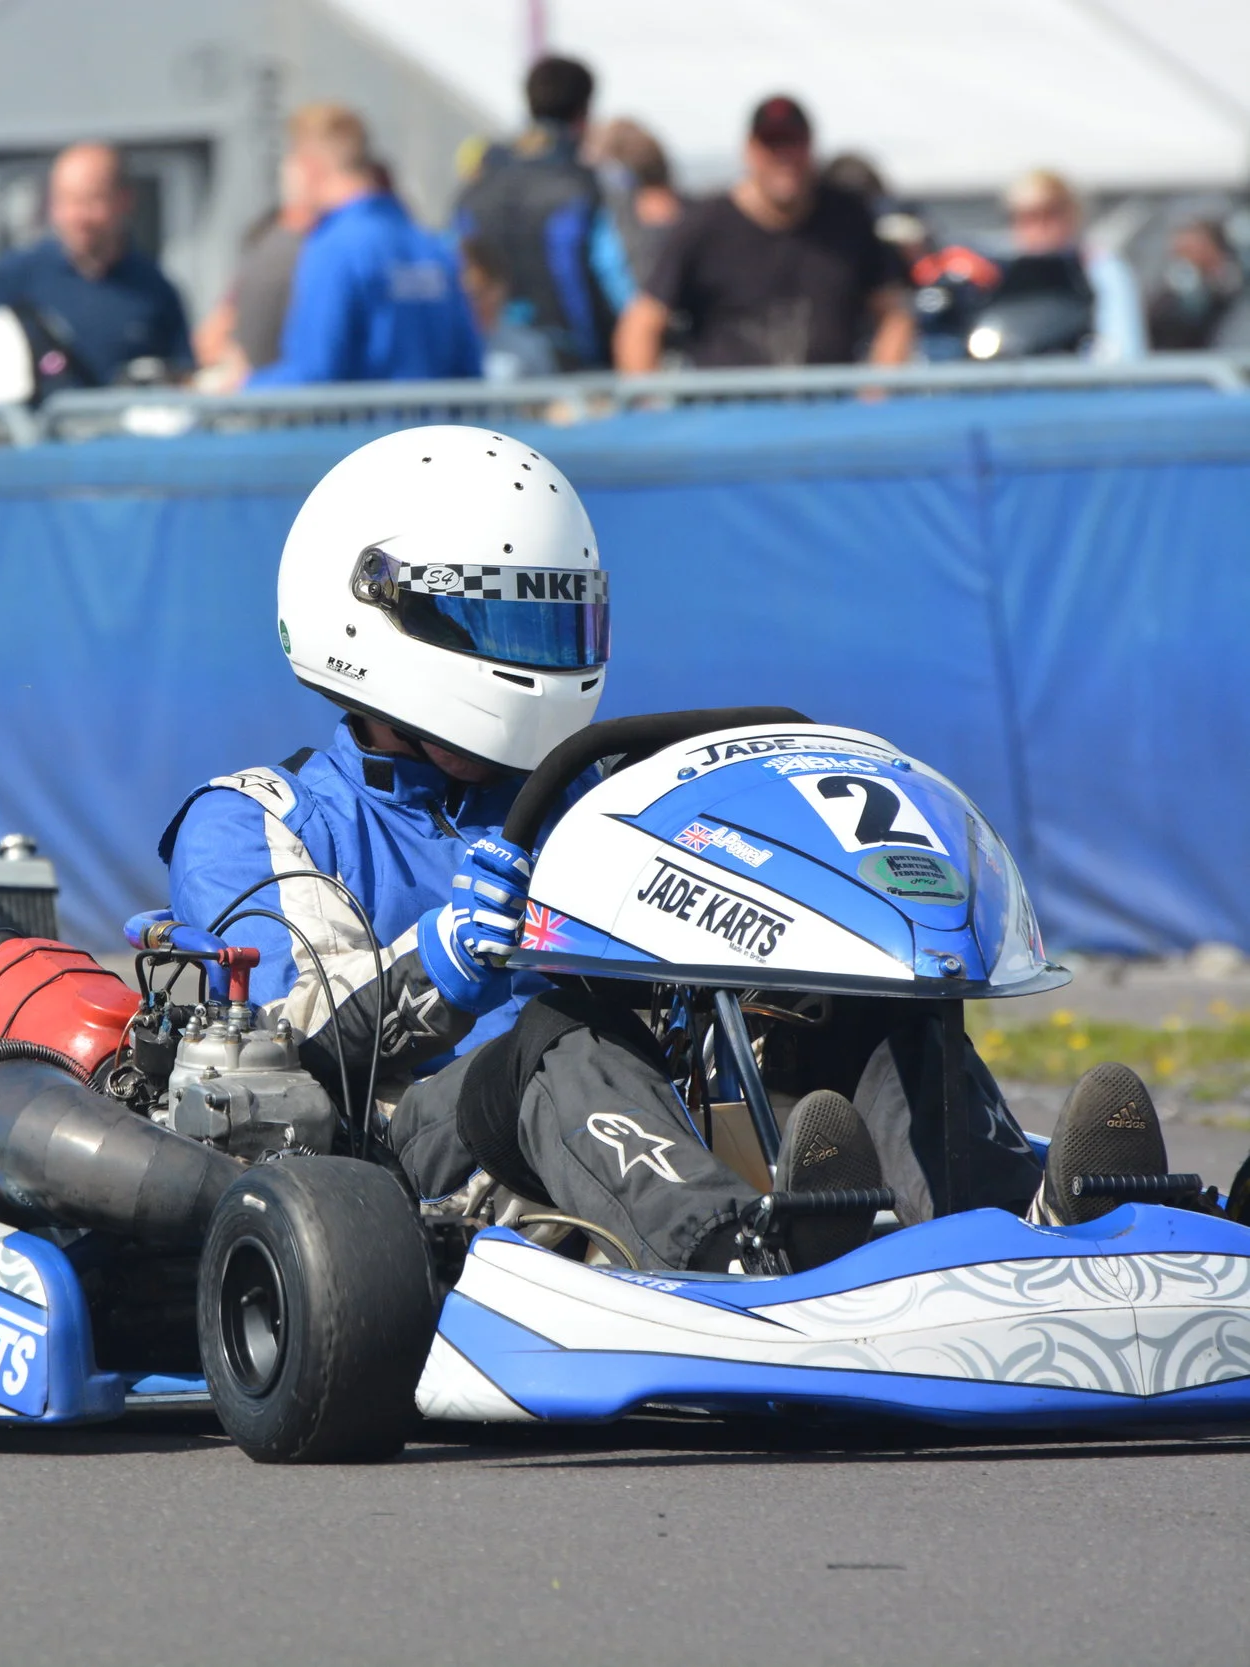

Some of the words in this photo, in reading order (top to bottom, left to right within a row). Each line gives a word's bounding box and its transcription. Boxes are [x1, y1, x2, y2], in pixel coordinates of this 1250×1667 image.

[426, 570, 454, 585] S4
[516, 572, 587, 601] NKF
[328, 656, 367, 677] RS7-K
[698, 738, 796, 766] JADE
[816, 775, 934, 849] 2
[637, 859, 708, 922] JADE
[696, 893, 786, 957] KARTS
[1106, 1119, 1146, 1129] adidas
